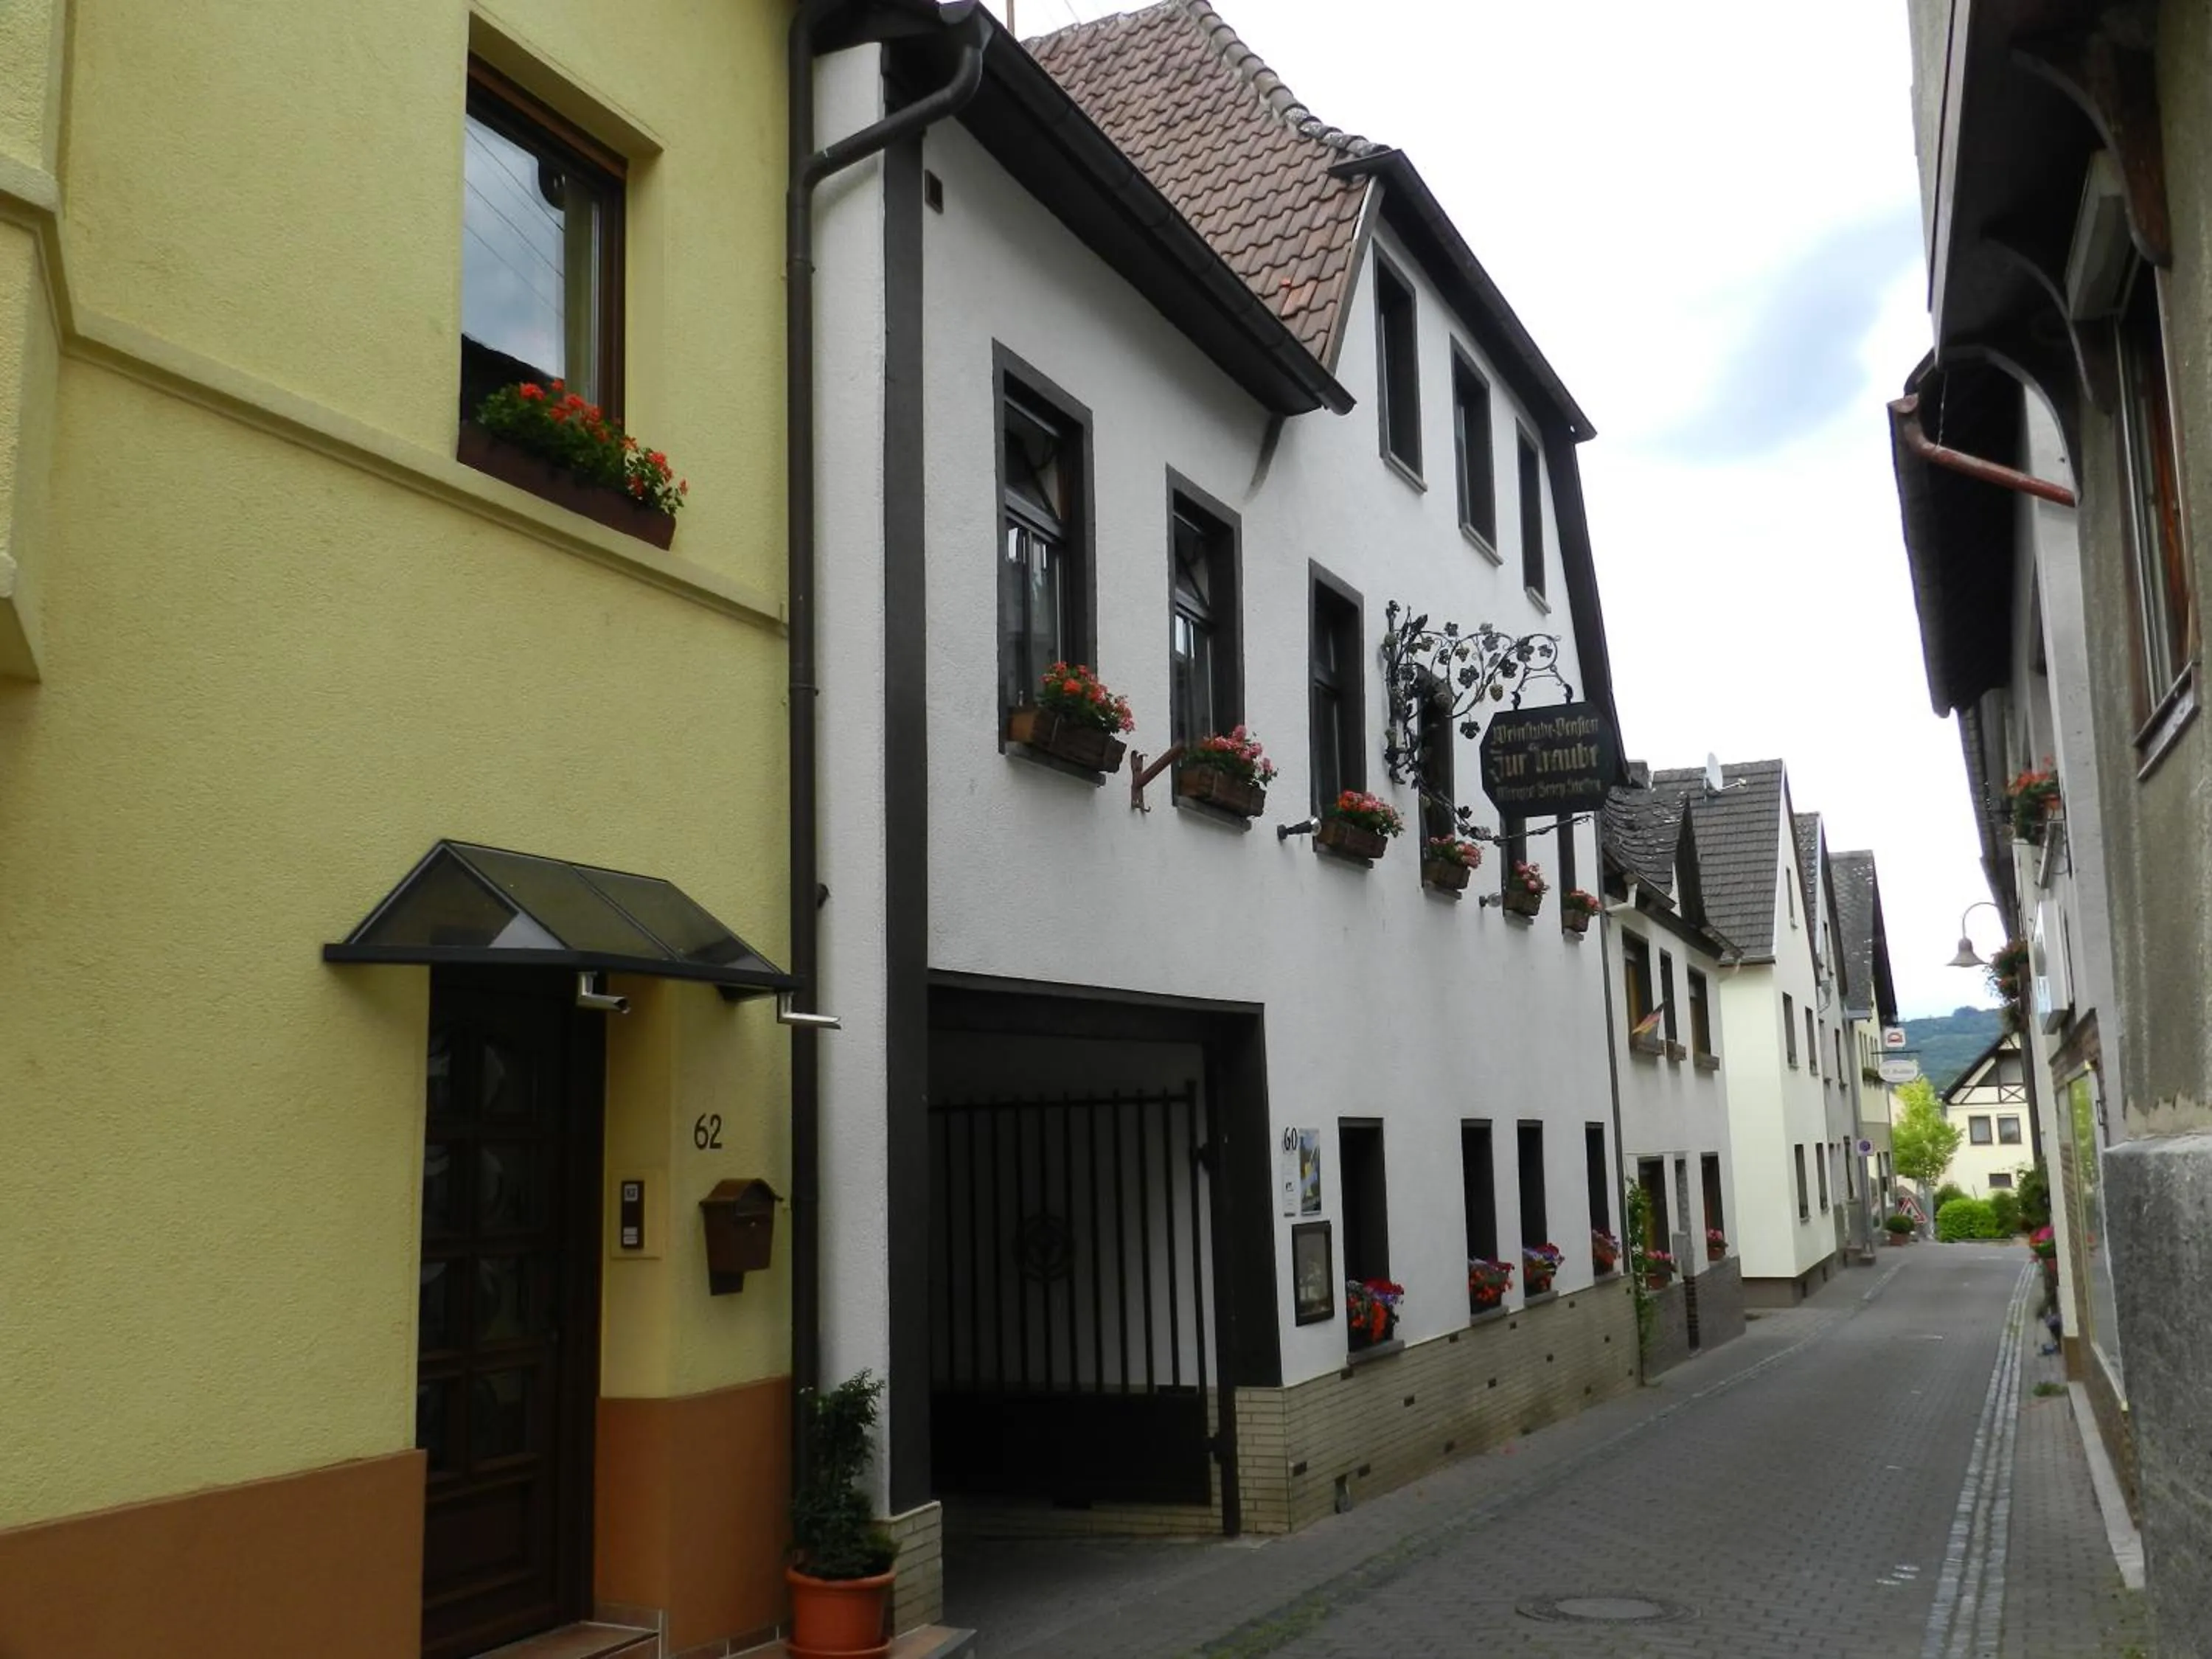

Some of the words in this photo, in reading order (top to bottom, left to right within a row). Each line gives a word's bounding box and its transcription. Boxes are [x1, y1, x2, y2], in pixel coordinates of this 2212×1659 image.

[1489, 748, 1528, 783] Zur
[1528, 742, 1599, 773] Traube
[694, 1113, 723, 1150] 62
[1284, 1127, 1298, 1151] 60
